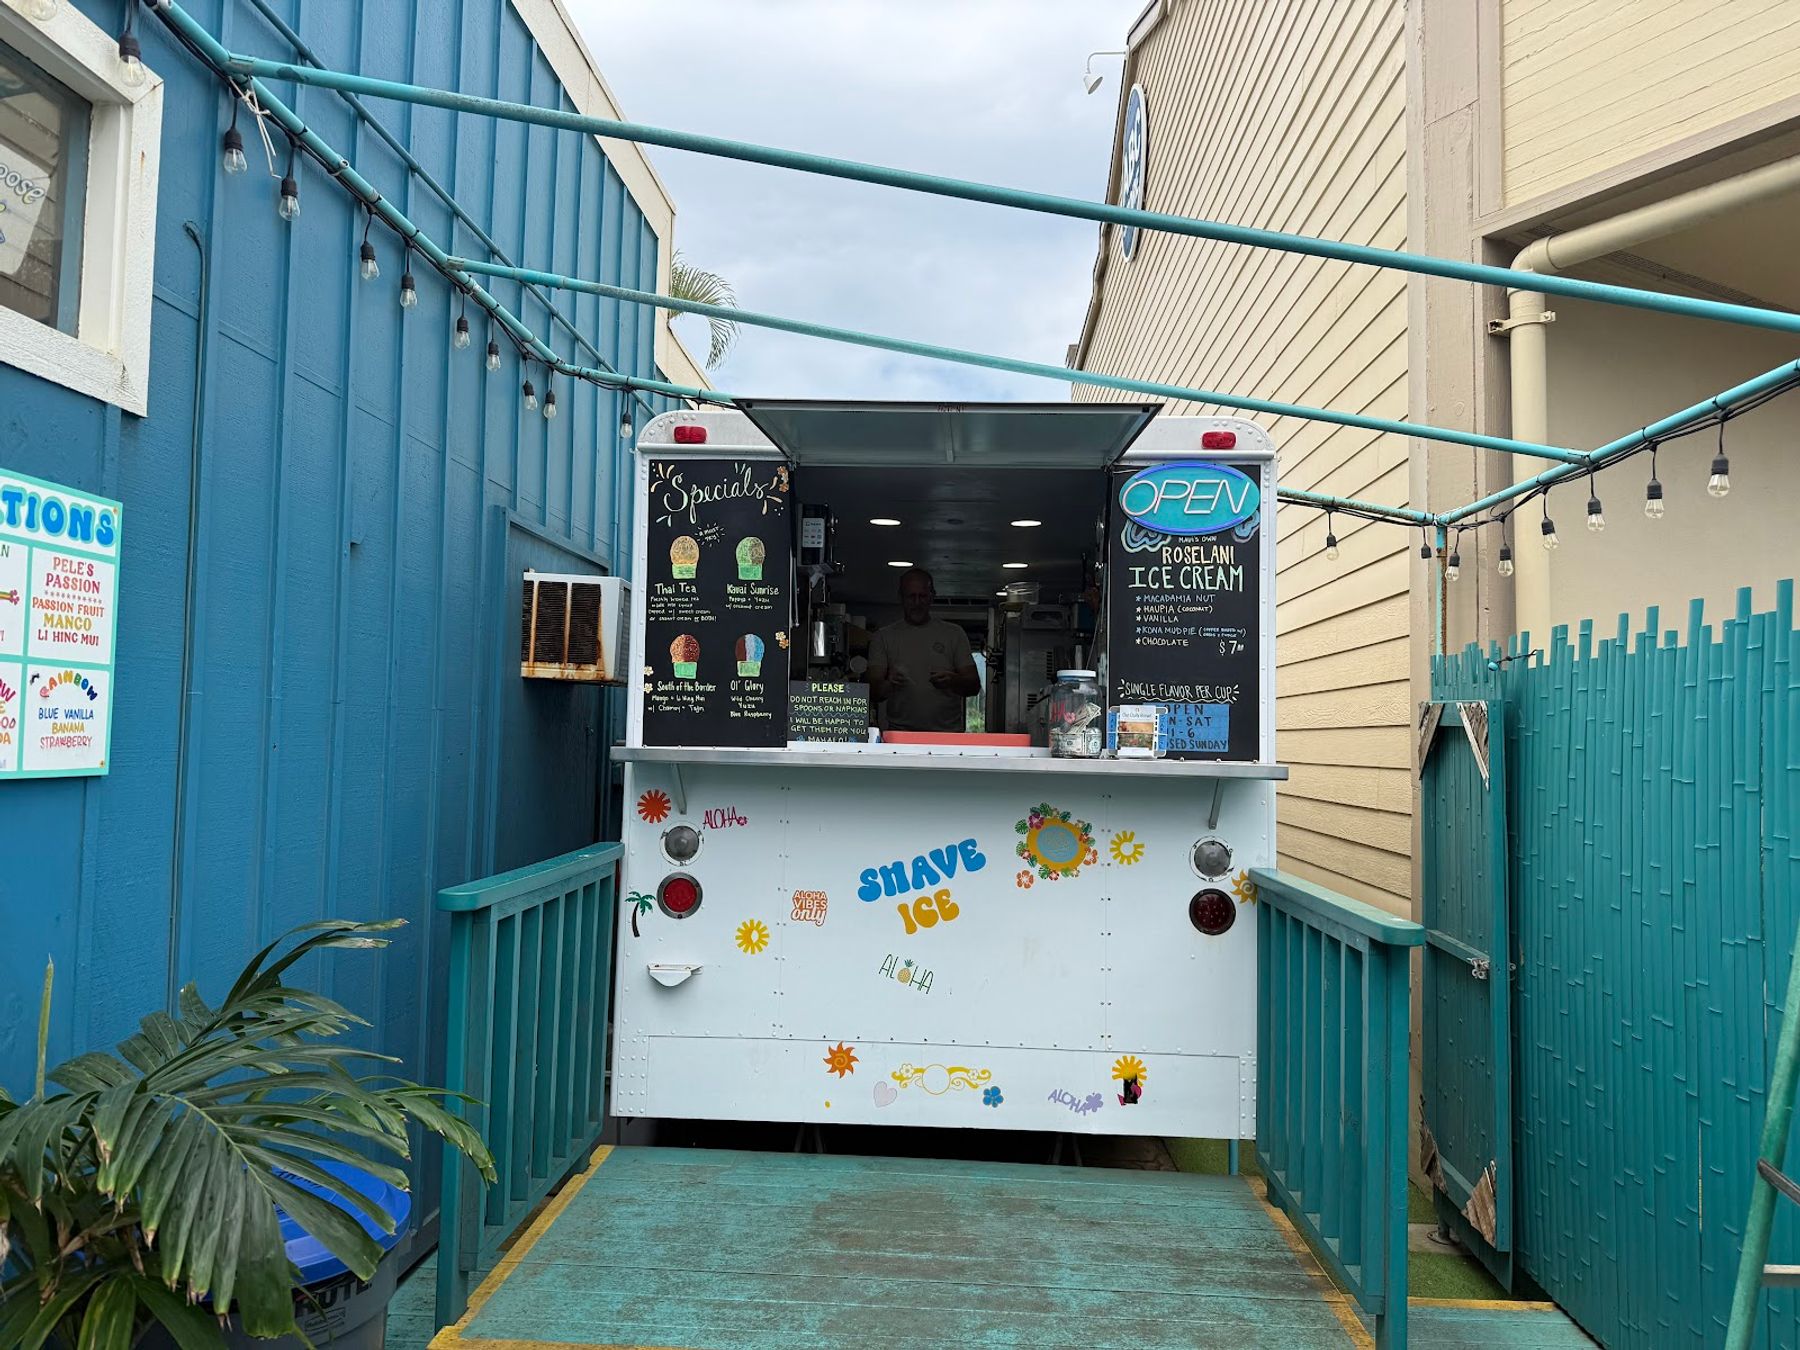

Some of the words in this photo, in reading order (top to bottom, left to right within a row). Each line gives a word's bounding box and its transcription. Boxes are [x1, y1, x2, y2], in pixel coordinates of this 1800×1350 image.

[0, 162, 45, 205] oose
[664, 466, 769, 524] Specials
[1122, 479, 1250, 516] OPEN
[1, 489, 115, 546] TIONS
[1162, 545, 1235, 565] ROSELANI
[53, 556, 95, 578] PELE'S
[45, 573, 101, 595] PASSION
[1128, 566, 1174, 589] ICE
[1180, 565, 1244, 592] CREAM
[655, 582, 675, 595] Thai
[679, 582, 697, 594] Tea
[750, 582, 779, 595] Sunrise
[1143, 594, 1191, 603] MACADAMIA
[1195, 594, 1216, 603] NUT
[32, 595, 75, 615] PASSION
[77, 602, 105, 618] FRUIT
[1143, 604, 1174, 614] HAUPIA
[1143, 614, 1179, 623] VANILLA
[37, 629, 49, 640] LI
[80, 632, 100, 646] MUI
[1142, 626, 1163, 635] KONA
[1142, 637, 1189, 646] CHOCOLATE
[39, 670, 98, 701] RAINBOW
[745, 680, 764, 694] Glory
[811, 683, 845, 693] PLEASE
[1124, 682, 1156, 696] SINGLE
[1159, 683, 1193, 698] FLAVOR
[1195, 686, 1212, 699] PER
[1215, 686, 1233, 700] CUP
[794, 704, 823, 712] SPOONS
[836, 705, 867, 713] NAPKINS
[843, 697, 851, 705] IN
[853, 698, 867, 706] FOR
[39, 707, 59, 720] BLUE
[64, 708, 95, 721] VANILLA
[795, 716, 811, 724] WILL
[825, 717, 850, 726] HAPPY
[1186, 716, 1212, 726] SAT
[52, 722, 85, 734] BANANA
[790, 725, 806, 733] GET
[834, 726, 848, 734] FOR
[850, 727, 867, 735] YOU
[1187, 728, 1195, 738] 6
[40, 735, 92, 749] STRAWBERRY
[1189, 739, 1227, 750] SUNDAY
[703, 806, 739, 830] ALOHA
[858, 838, 987, 902] SHAVE
[793, 890, 827, 901] ALOHA
[794, 899, 828, 910] VIBES
[897, 888, 960, 935] ICE
[791, 908, 827, 926] only
[1048, 1088, 1087, 1117] ALOHA
